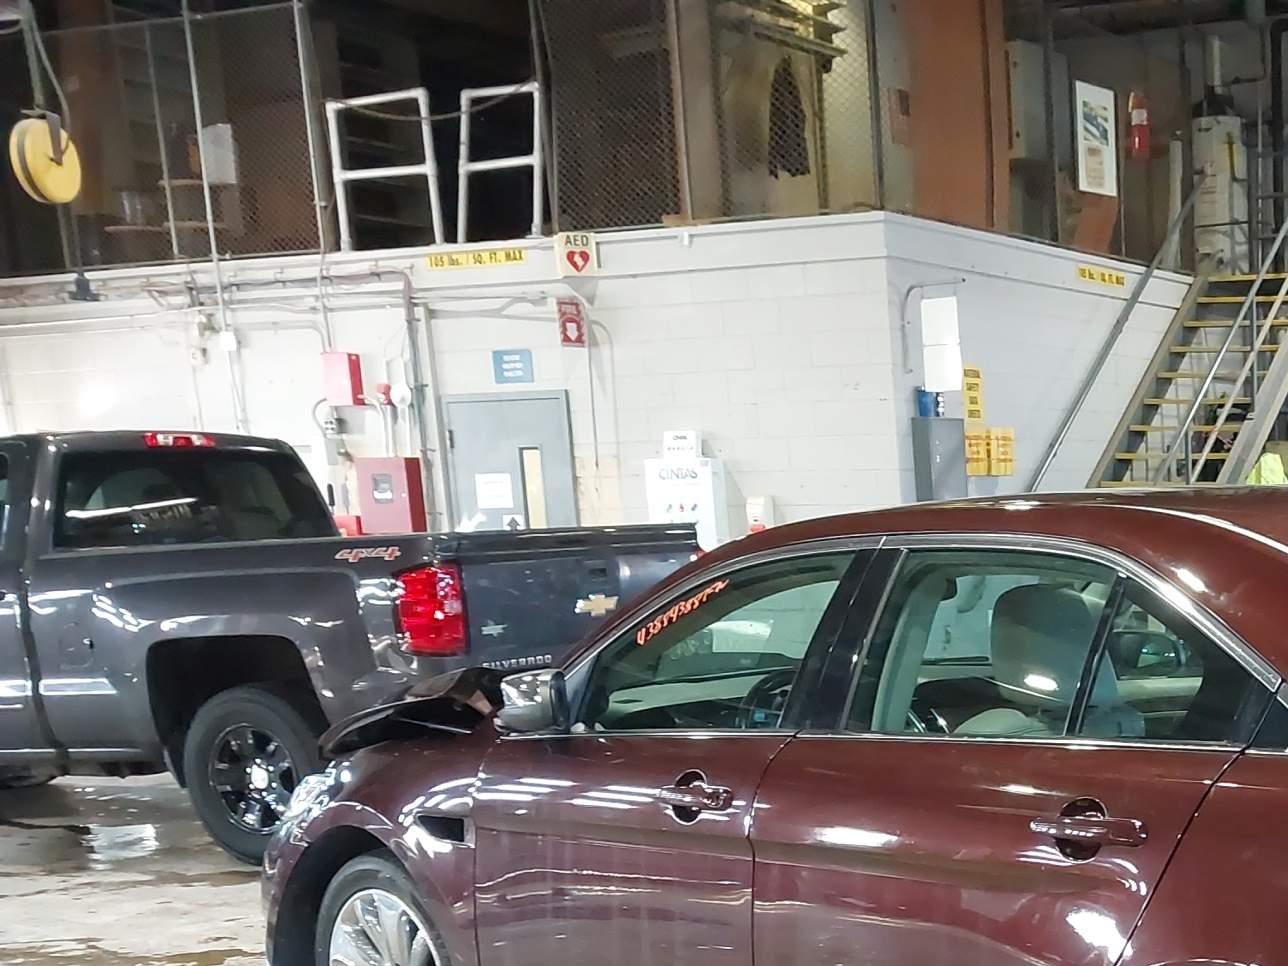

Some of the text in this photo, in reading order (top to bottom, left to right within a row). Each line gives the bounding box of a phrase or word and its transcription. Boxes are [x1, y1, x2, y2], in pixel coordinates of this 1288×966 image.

[564, 234, 589, 247] AED
[429, 256, 445, 268] 105
[448, 254, 463, 266] lbs.
[472, 253, 487, 265] SQ.
[489, 252, 502, 264] FT.
[505, 249, 524, 261] MAX
[658, 467, 698, 480] CINTAS
